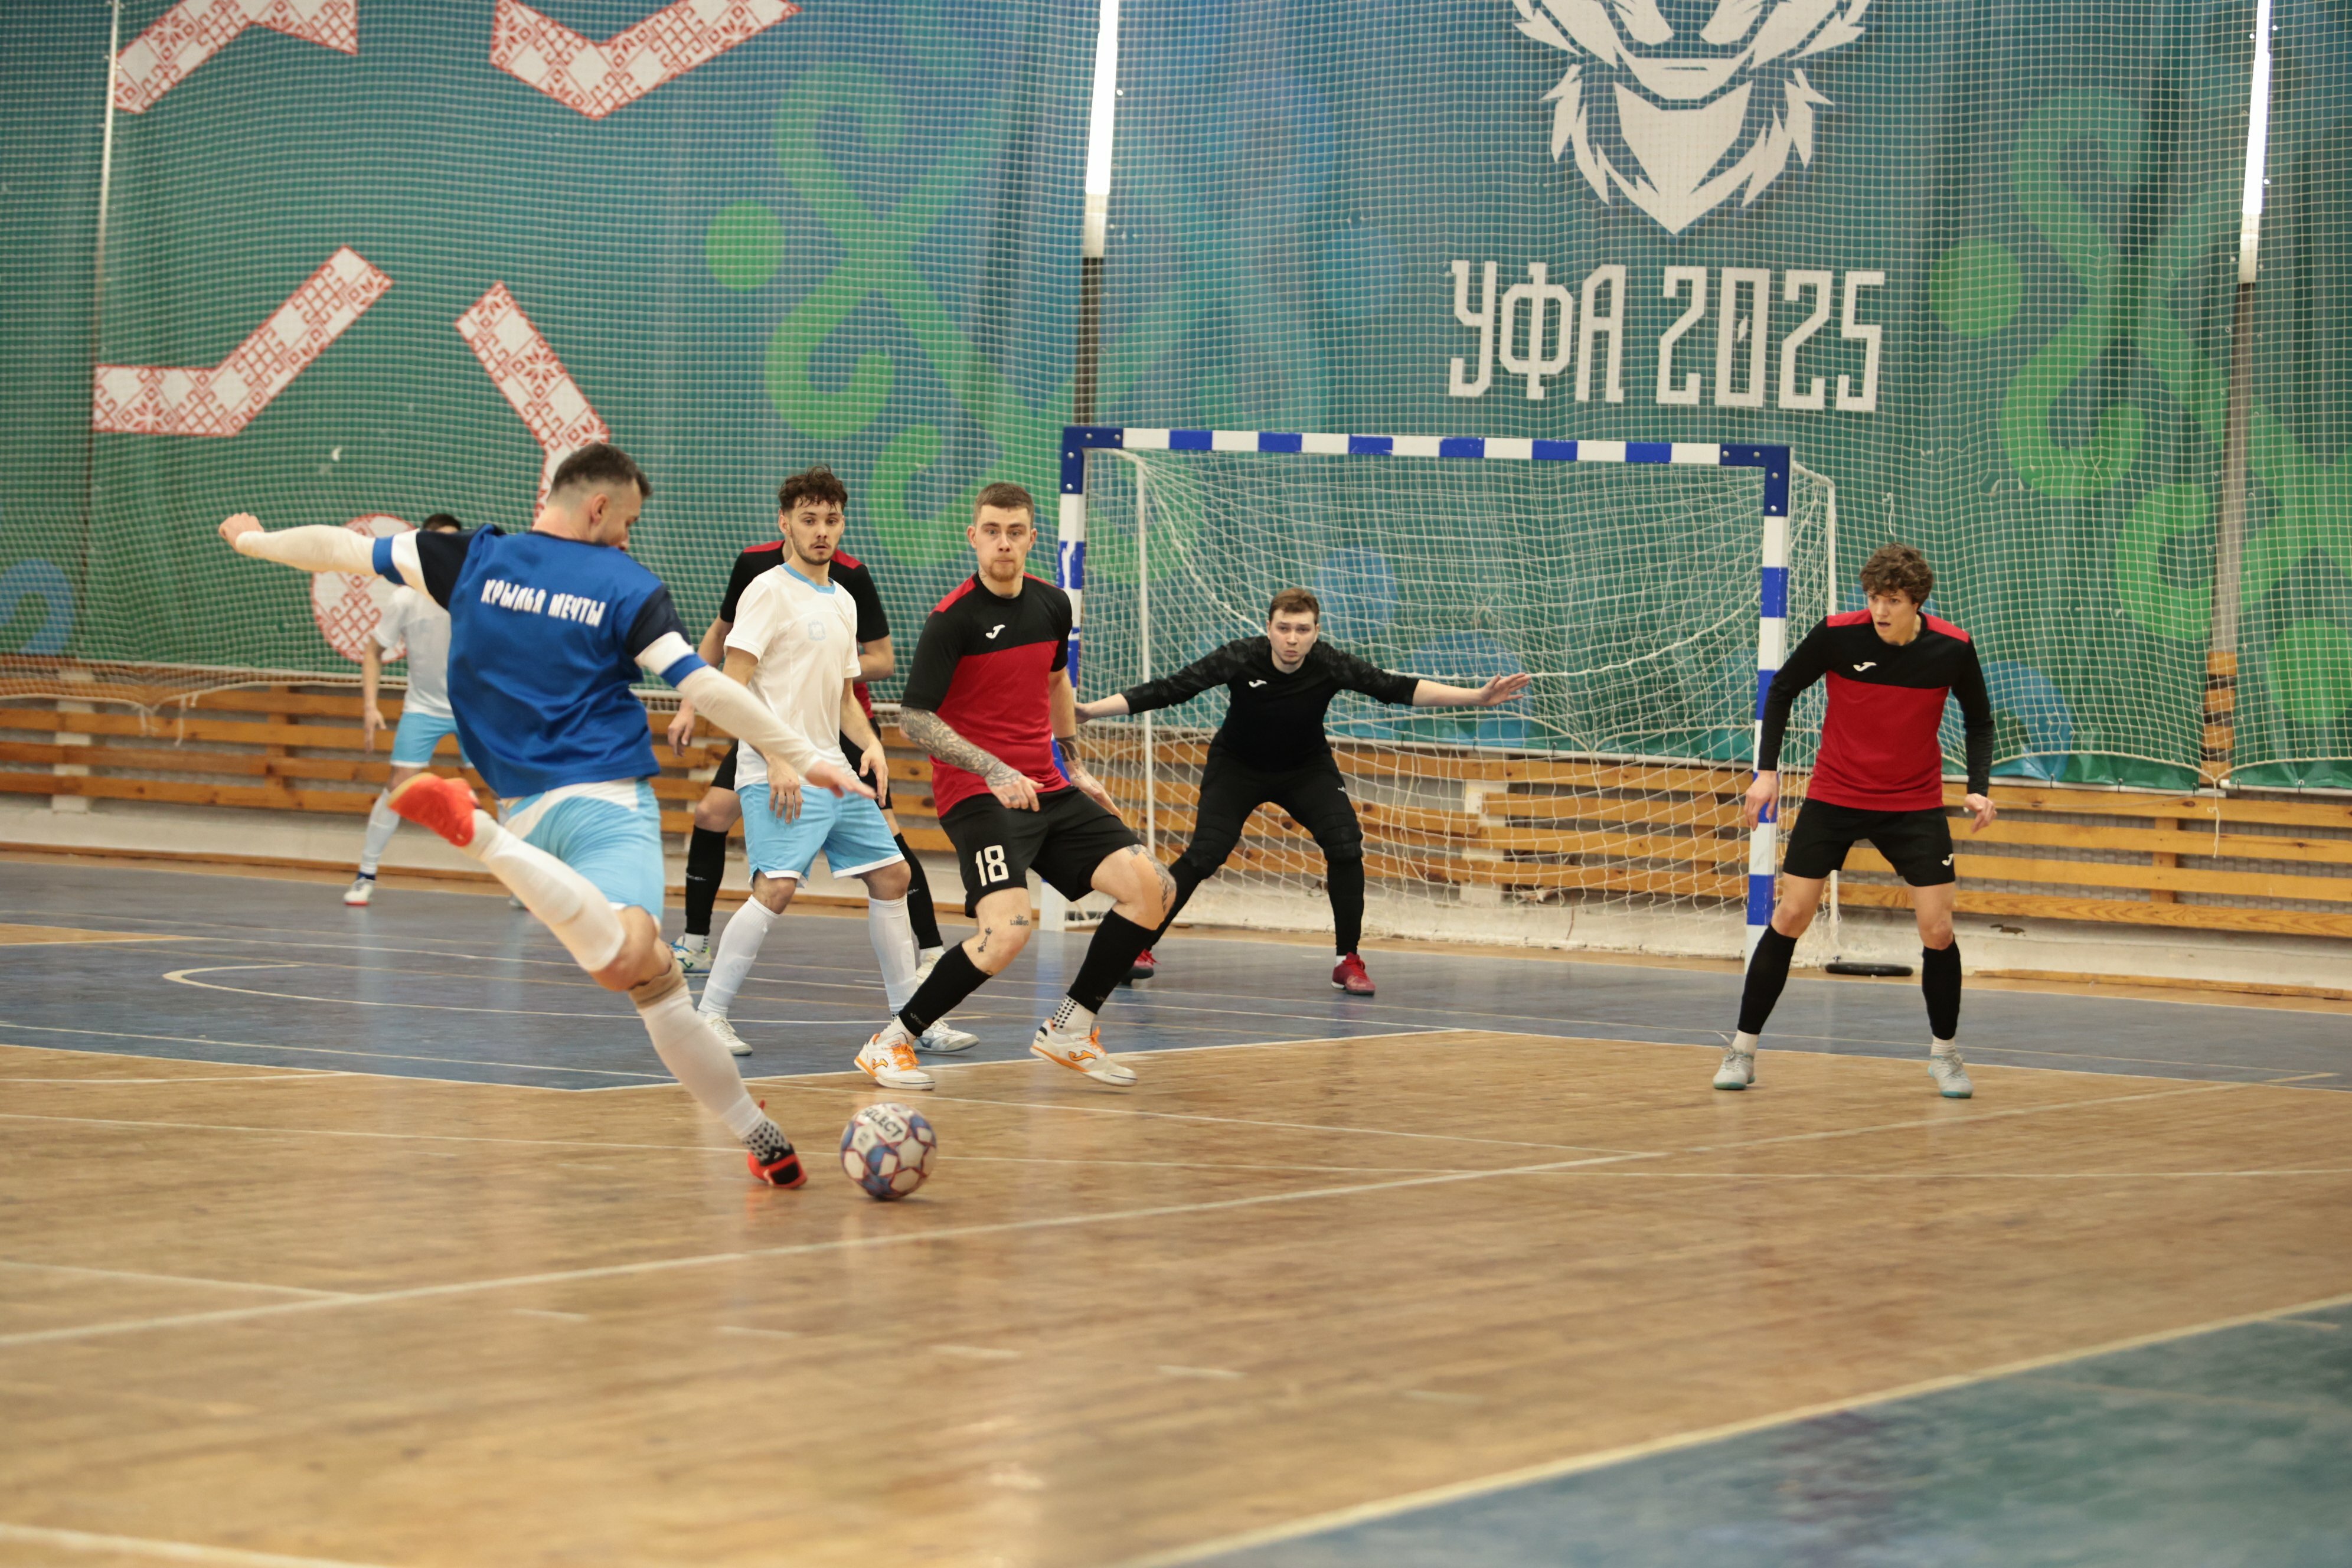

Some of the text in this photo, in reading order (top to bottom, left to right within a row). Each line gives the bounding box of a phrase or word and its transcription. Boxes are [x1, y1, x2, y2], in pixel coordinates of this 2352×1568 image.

[1448, 260, 1886, 411] УФА 2025
[481, 579, 606, 628] КРЫЛЬЯ МЕЧТЫ
[975, 845, 1009, 886] 18
[863, 1108, 903, 1137] SELECT
